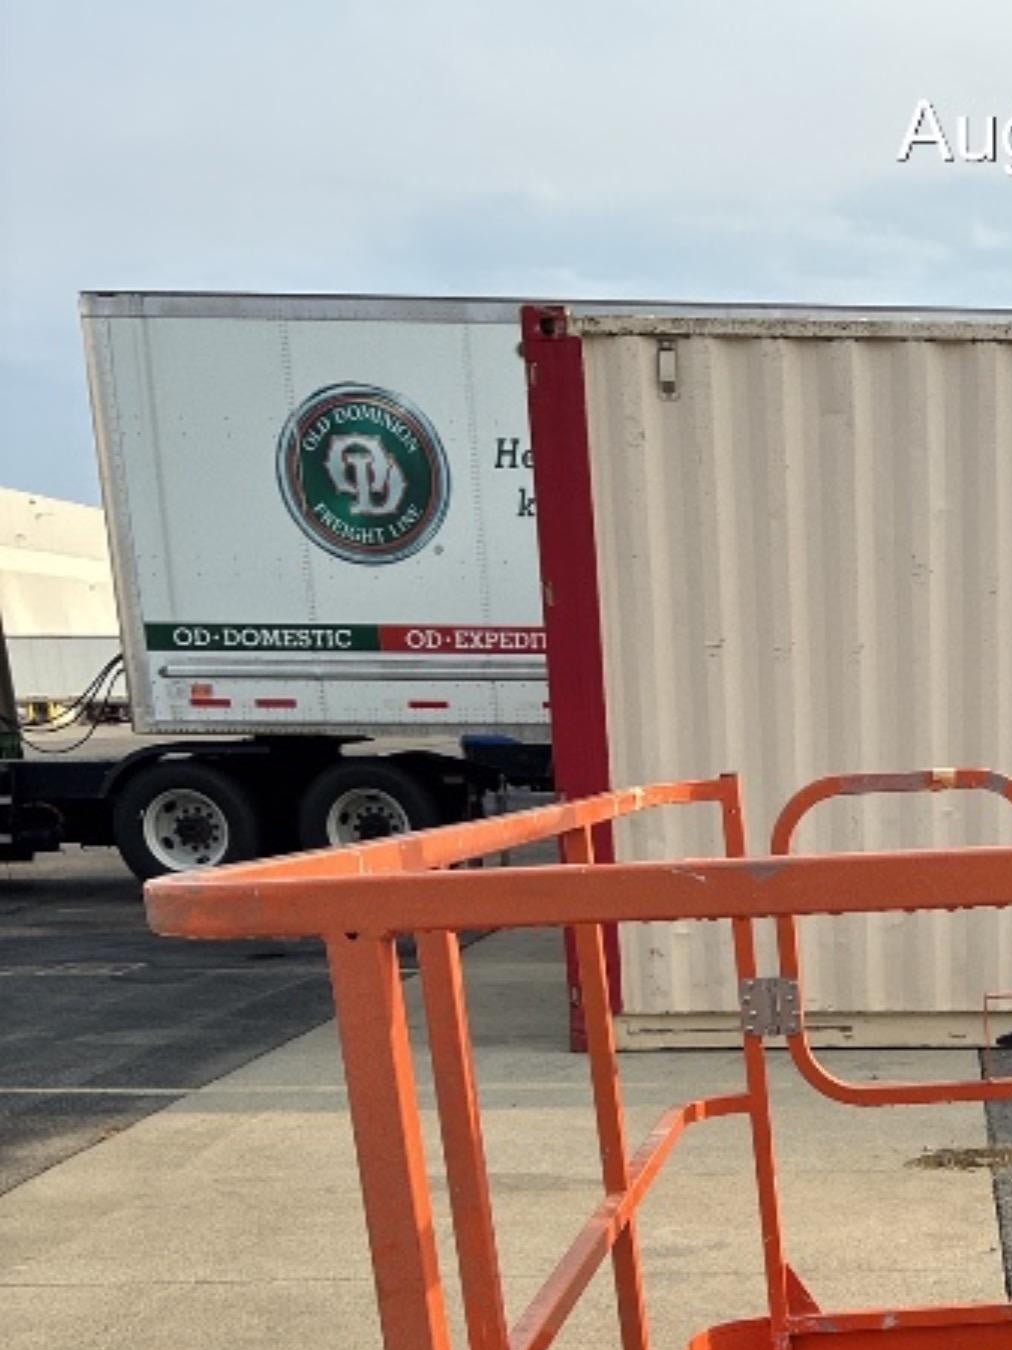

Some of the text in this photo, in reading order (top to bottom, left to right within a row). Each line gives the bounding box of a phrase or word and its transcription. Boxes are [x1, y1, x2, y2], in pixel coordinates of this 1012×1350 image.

[303, 403, 420, 454] OLD DOMINION
[313, 503, 423, 544] FREIGHT LINE
